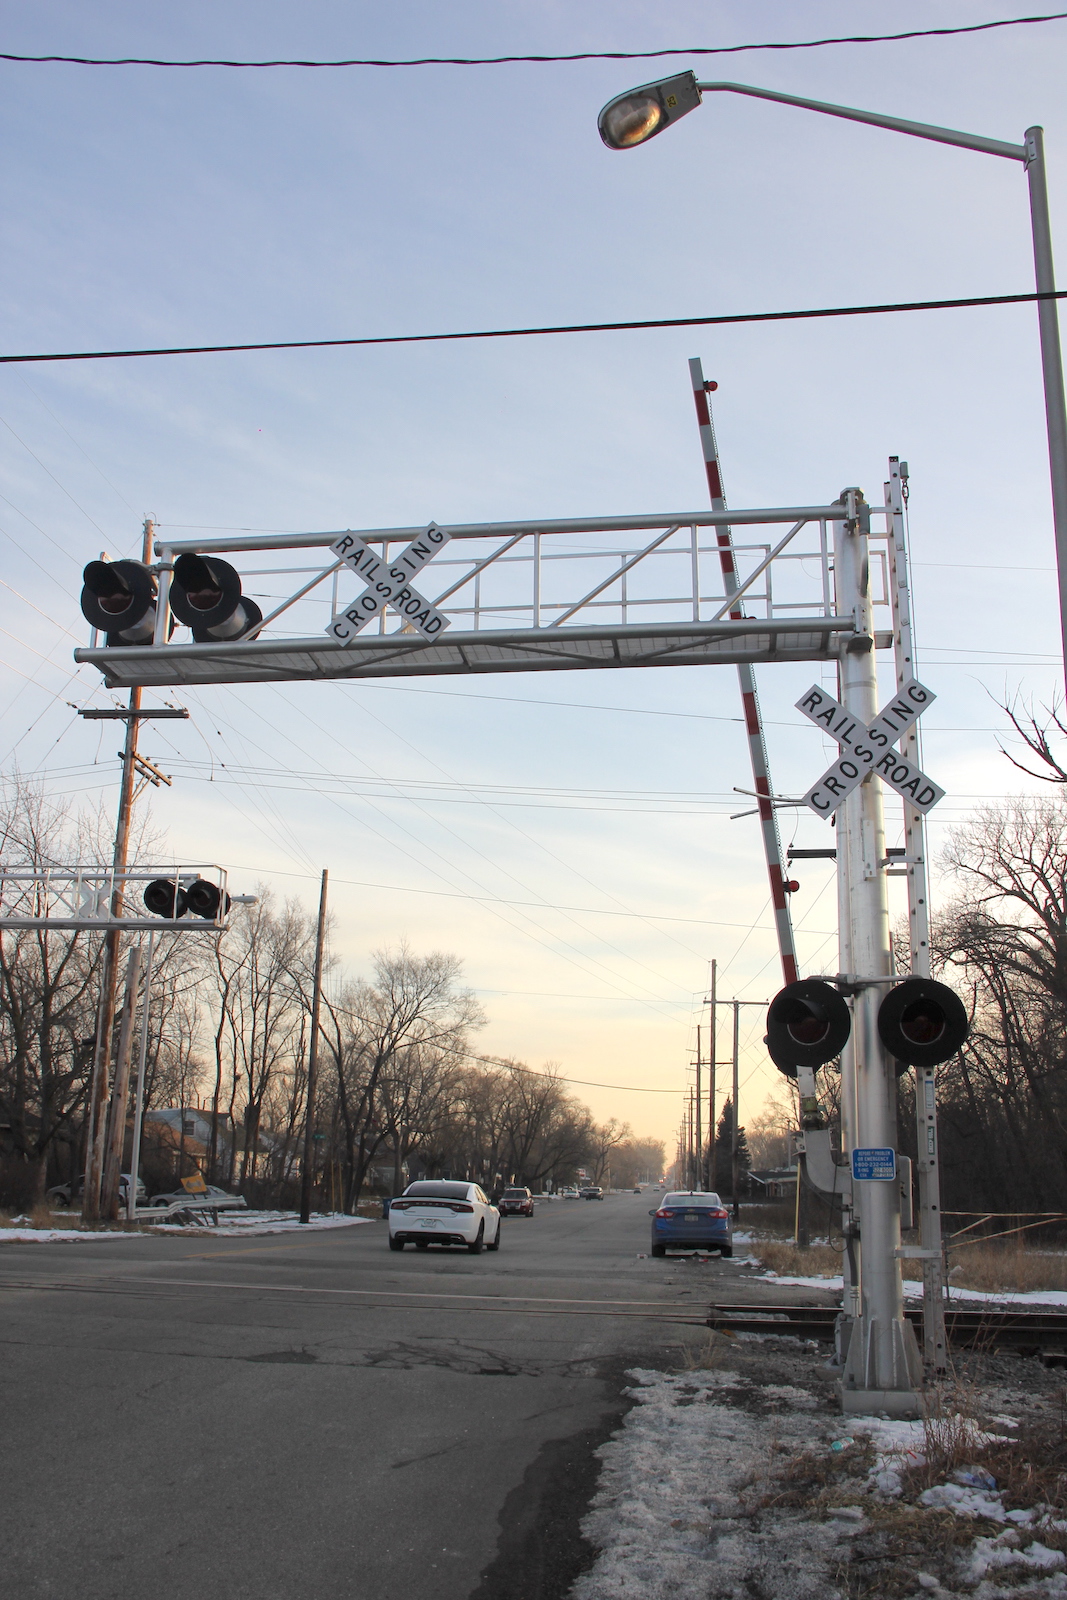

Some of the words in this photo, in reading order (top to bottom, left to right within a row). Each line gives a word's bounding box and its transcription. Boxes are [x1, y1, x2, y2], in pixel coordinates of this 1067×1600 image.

[333, 528, 444, 639] CROSSING
[335, 535, 380, 582] RAIL
[393, 588, 442, 634] ROAD
[802, 691, 856, 745] RAIL
[876, 752, 936, 806] ROAD
[810, 685, 927, 810] CROSSING
